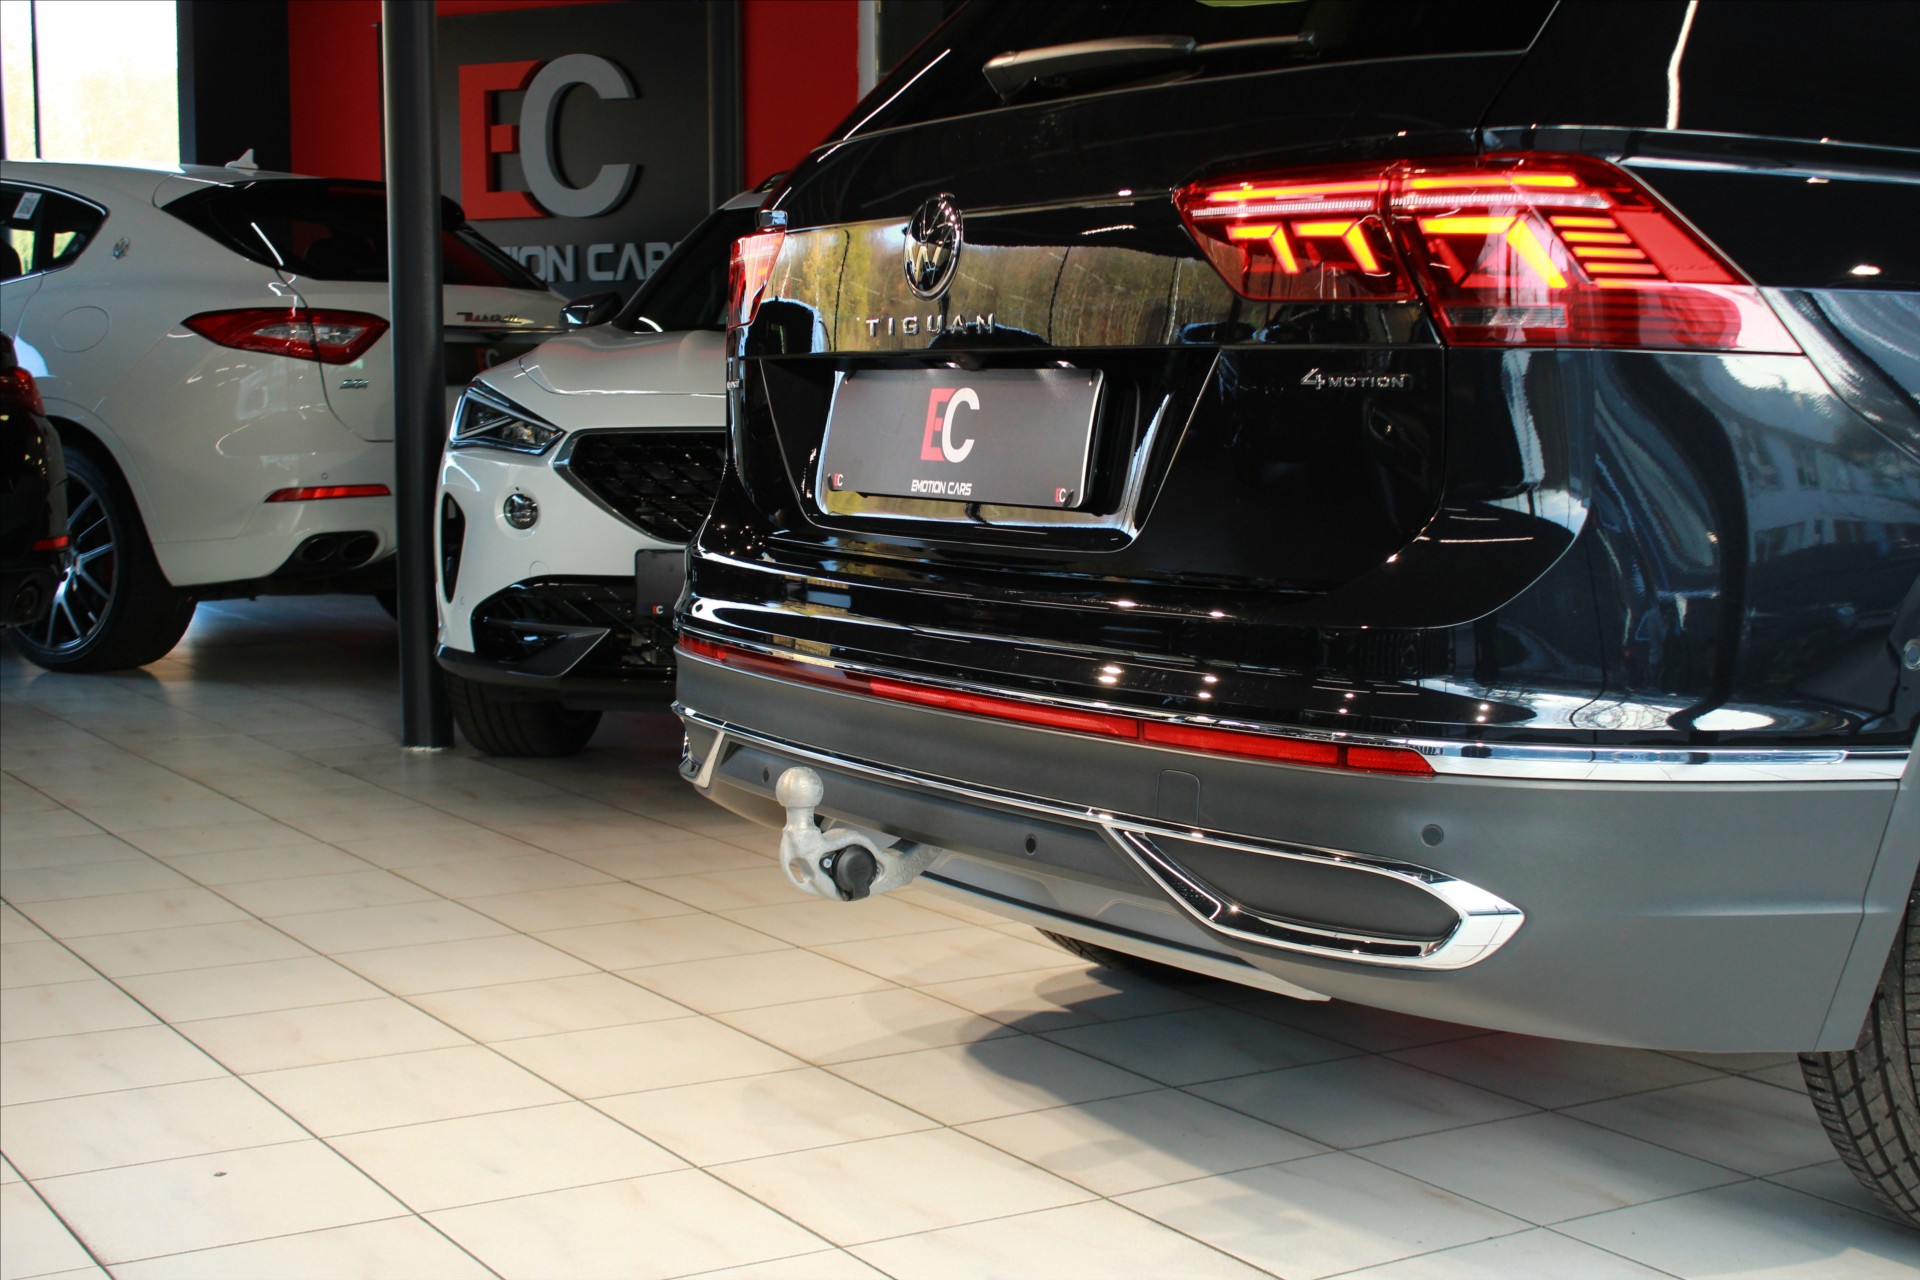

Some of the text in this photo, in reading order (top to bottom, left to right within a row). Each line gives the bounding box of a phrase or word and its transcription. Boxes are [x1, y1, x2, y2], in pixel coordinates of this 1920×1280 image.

[458, 53, 637, 220] EC
[587, 241, 682, 281] CAR
[865, 313, 996, 337] TIGUAN
[1300, 367, 1405, 390] 4MOTION
[920, 387, 980, 463] EC
[911, 479, 973, 496] EMOTION CARS
